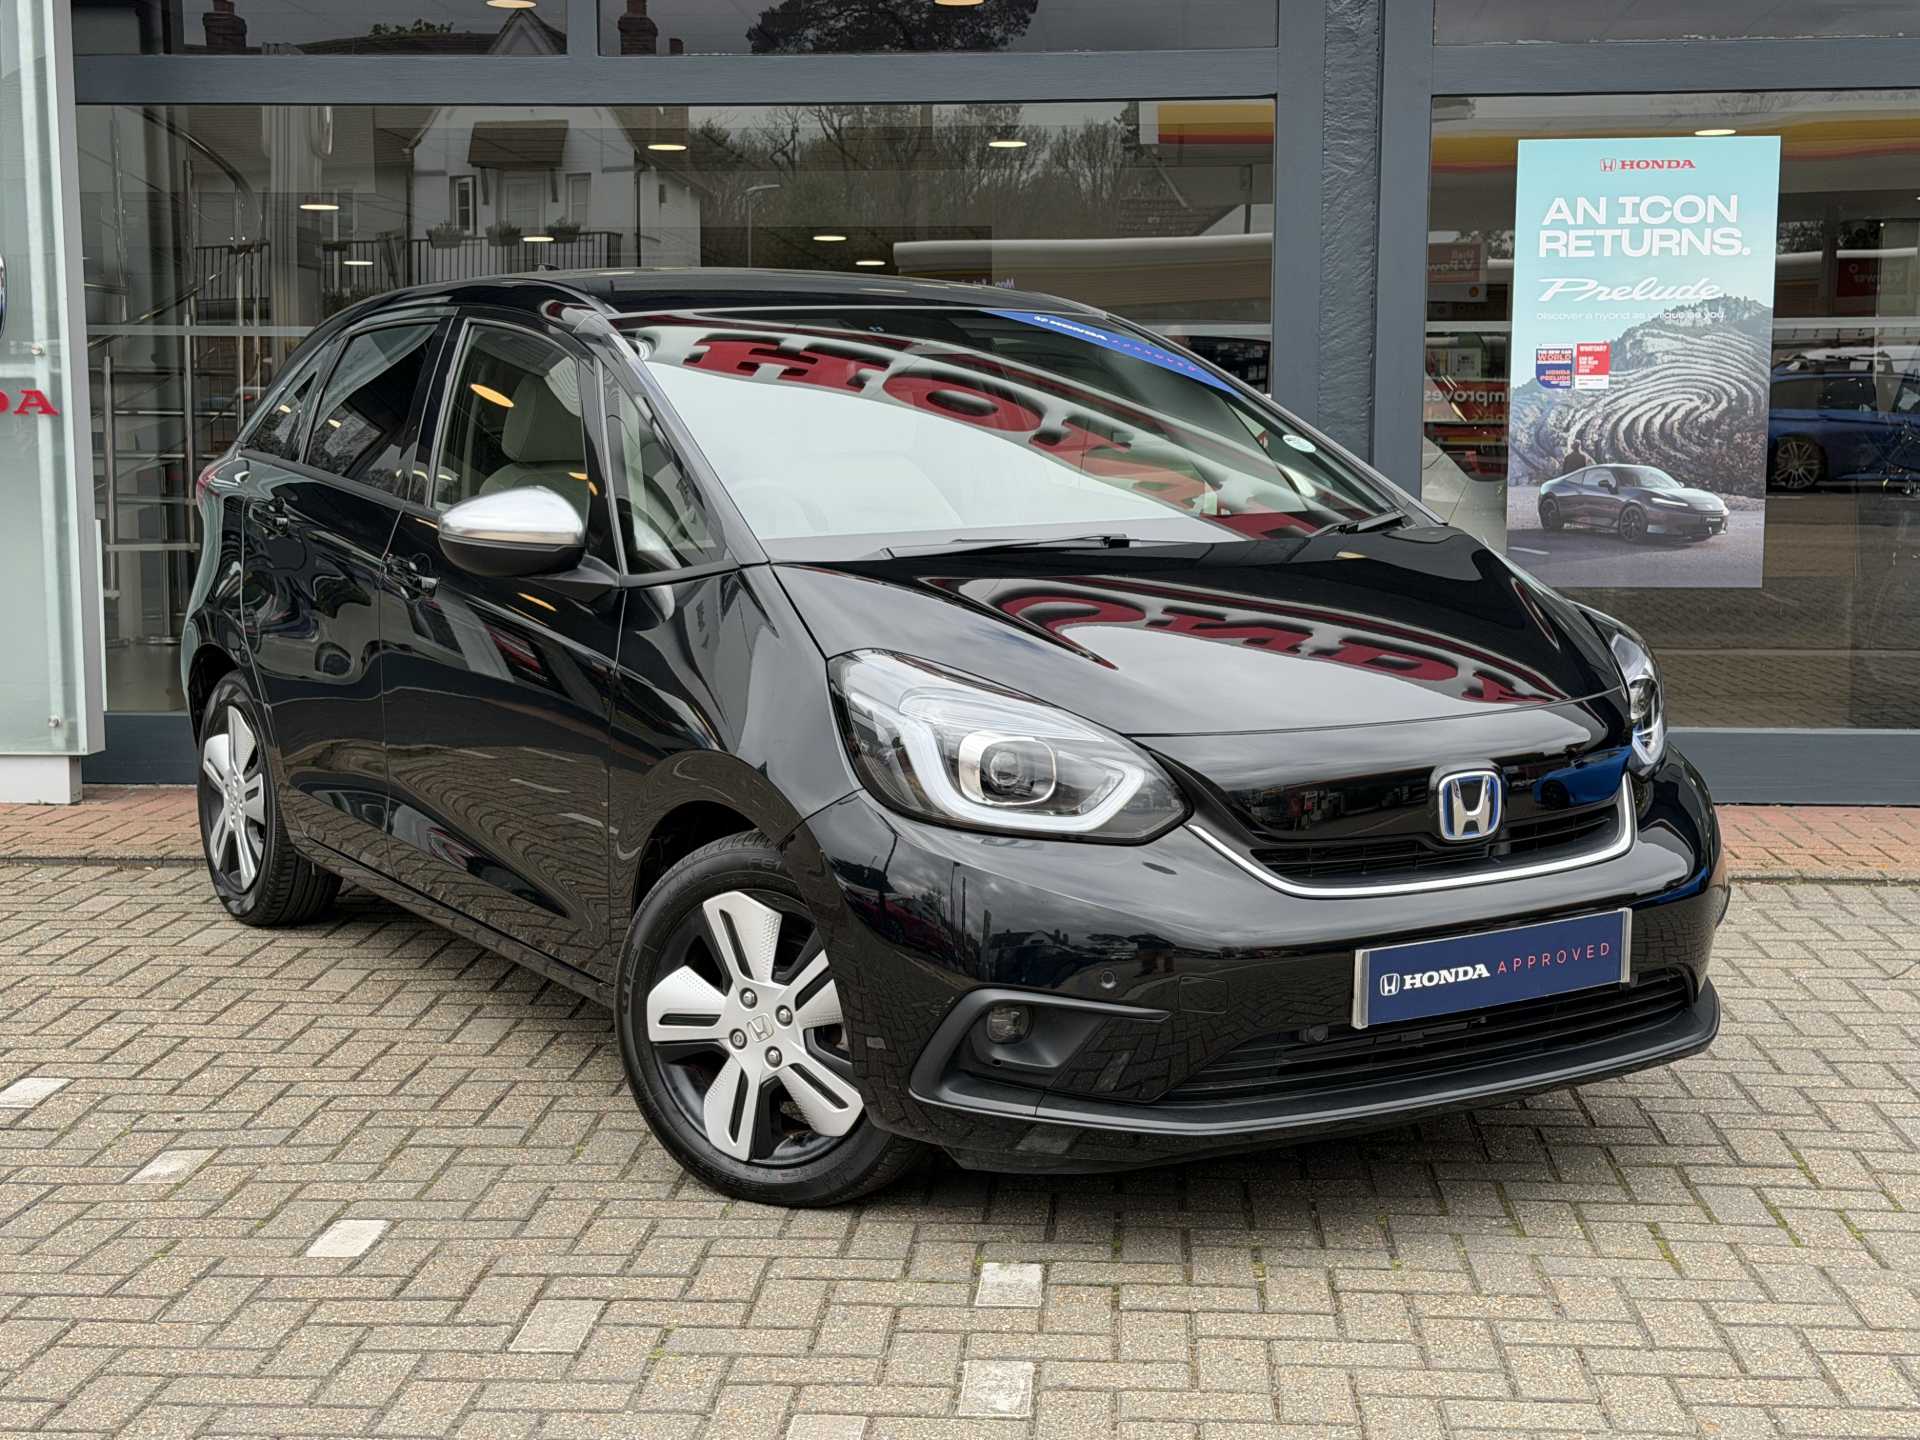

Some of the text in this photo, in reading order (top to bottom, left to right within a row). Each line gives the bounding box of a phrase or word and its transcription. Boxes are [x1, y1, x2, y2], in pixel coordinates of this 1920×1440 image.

[1620, 159, 1696, 170] HONDA
[1541, 194, 1738, 225] AN ICON
[1538, 227, 1750, 257] RETURNS.
[1538, 277, 1724, 302] Prelude
[1403, 963, 1490, 990] HONDA
[1498, 942, 1610, 974] APPROVED
